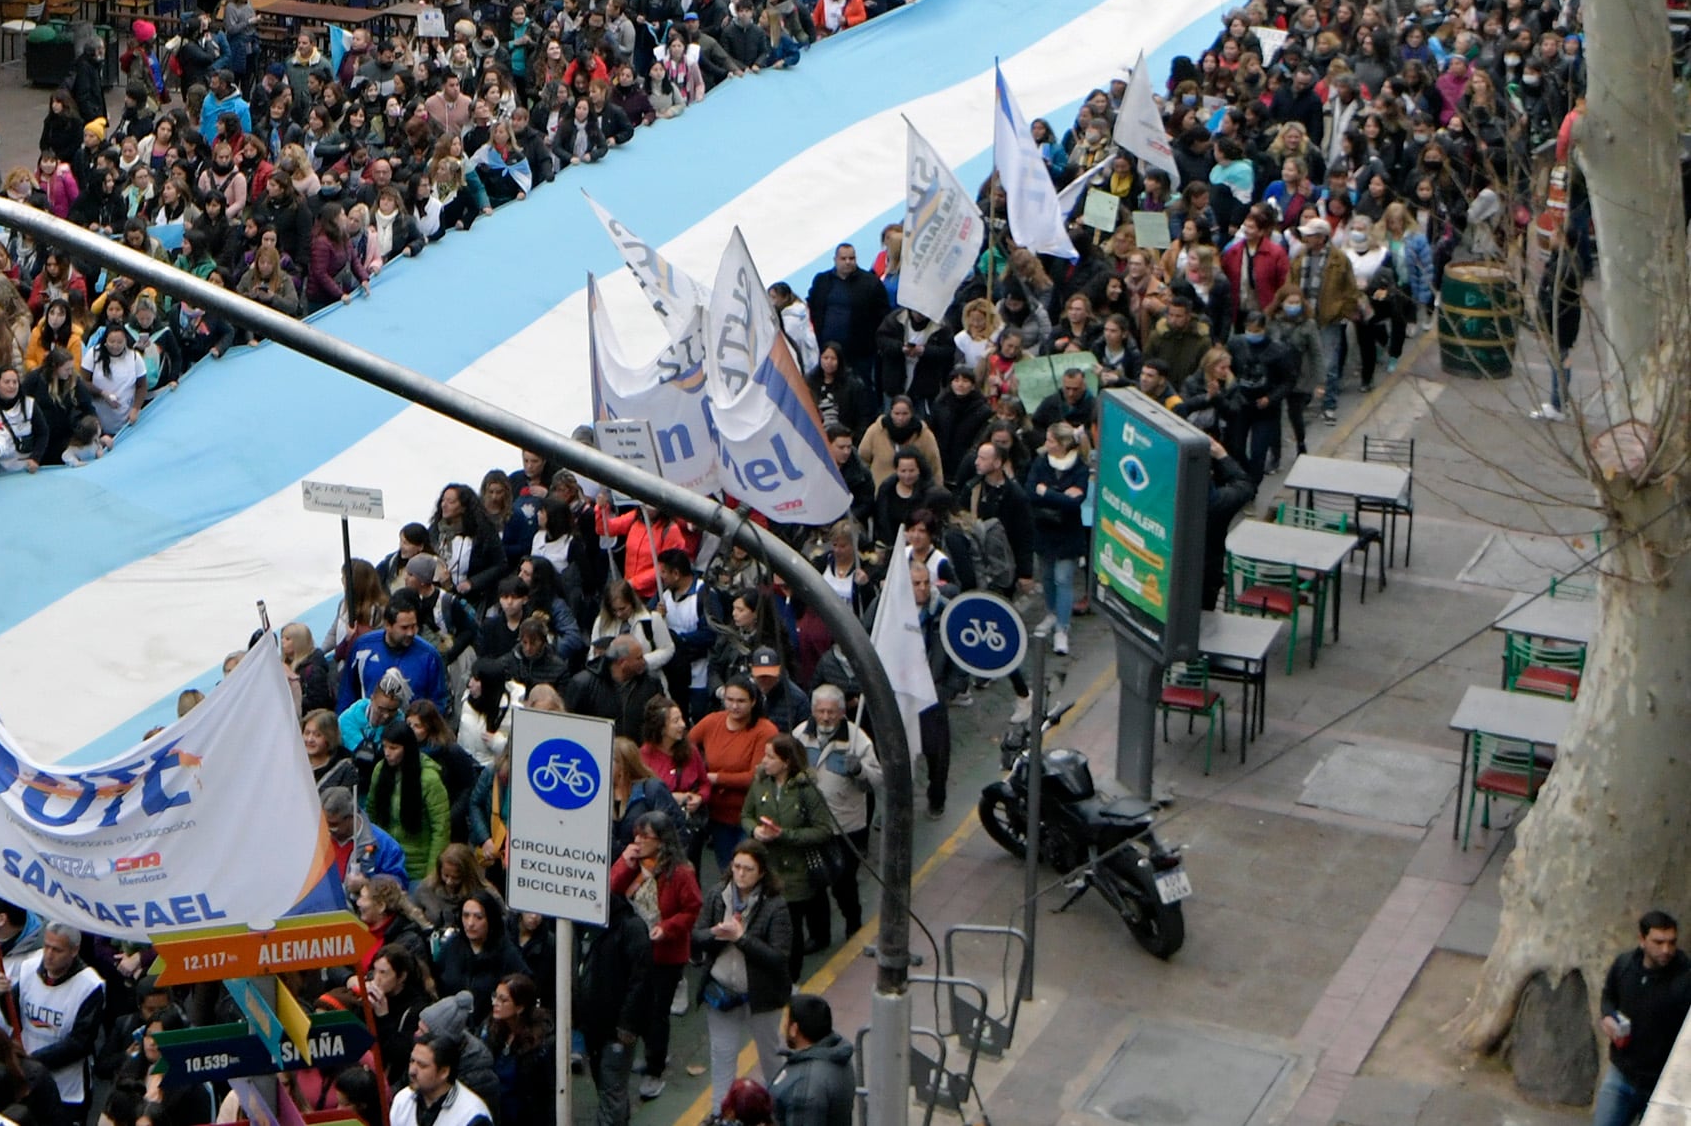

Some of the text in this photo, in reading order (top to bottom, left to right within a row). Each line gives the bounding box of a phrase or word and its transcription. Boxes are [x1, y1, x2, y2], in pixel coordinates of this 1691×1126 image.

[1131, 508, 1168, 541] ALERTA
[511, 837, 607, 865] CIRCULACIÓN
[118, 871, 168, 888] Mendoza
[520, 858, 596, 883] EXCLUSIVA
[517, 876, 598, 902] BICICLETAS
[183, 952, 226, 971] 12.117
[257, 934, 356, 965] ALEMANIA
[24, 1001, 64, 1028] SUTE
[185, 1052, 229, 1073] 10.539
